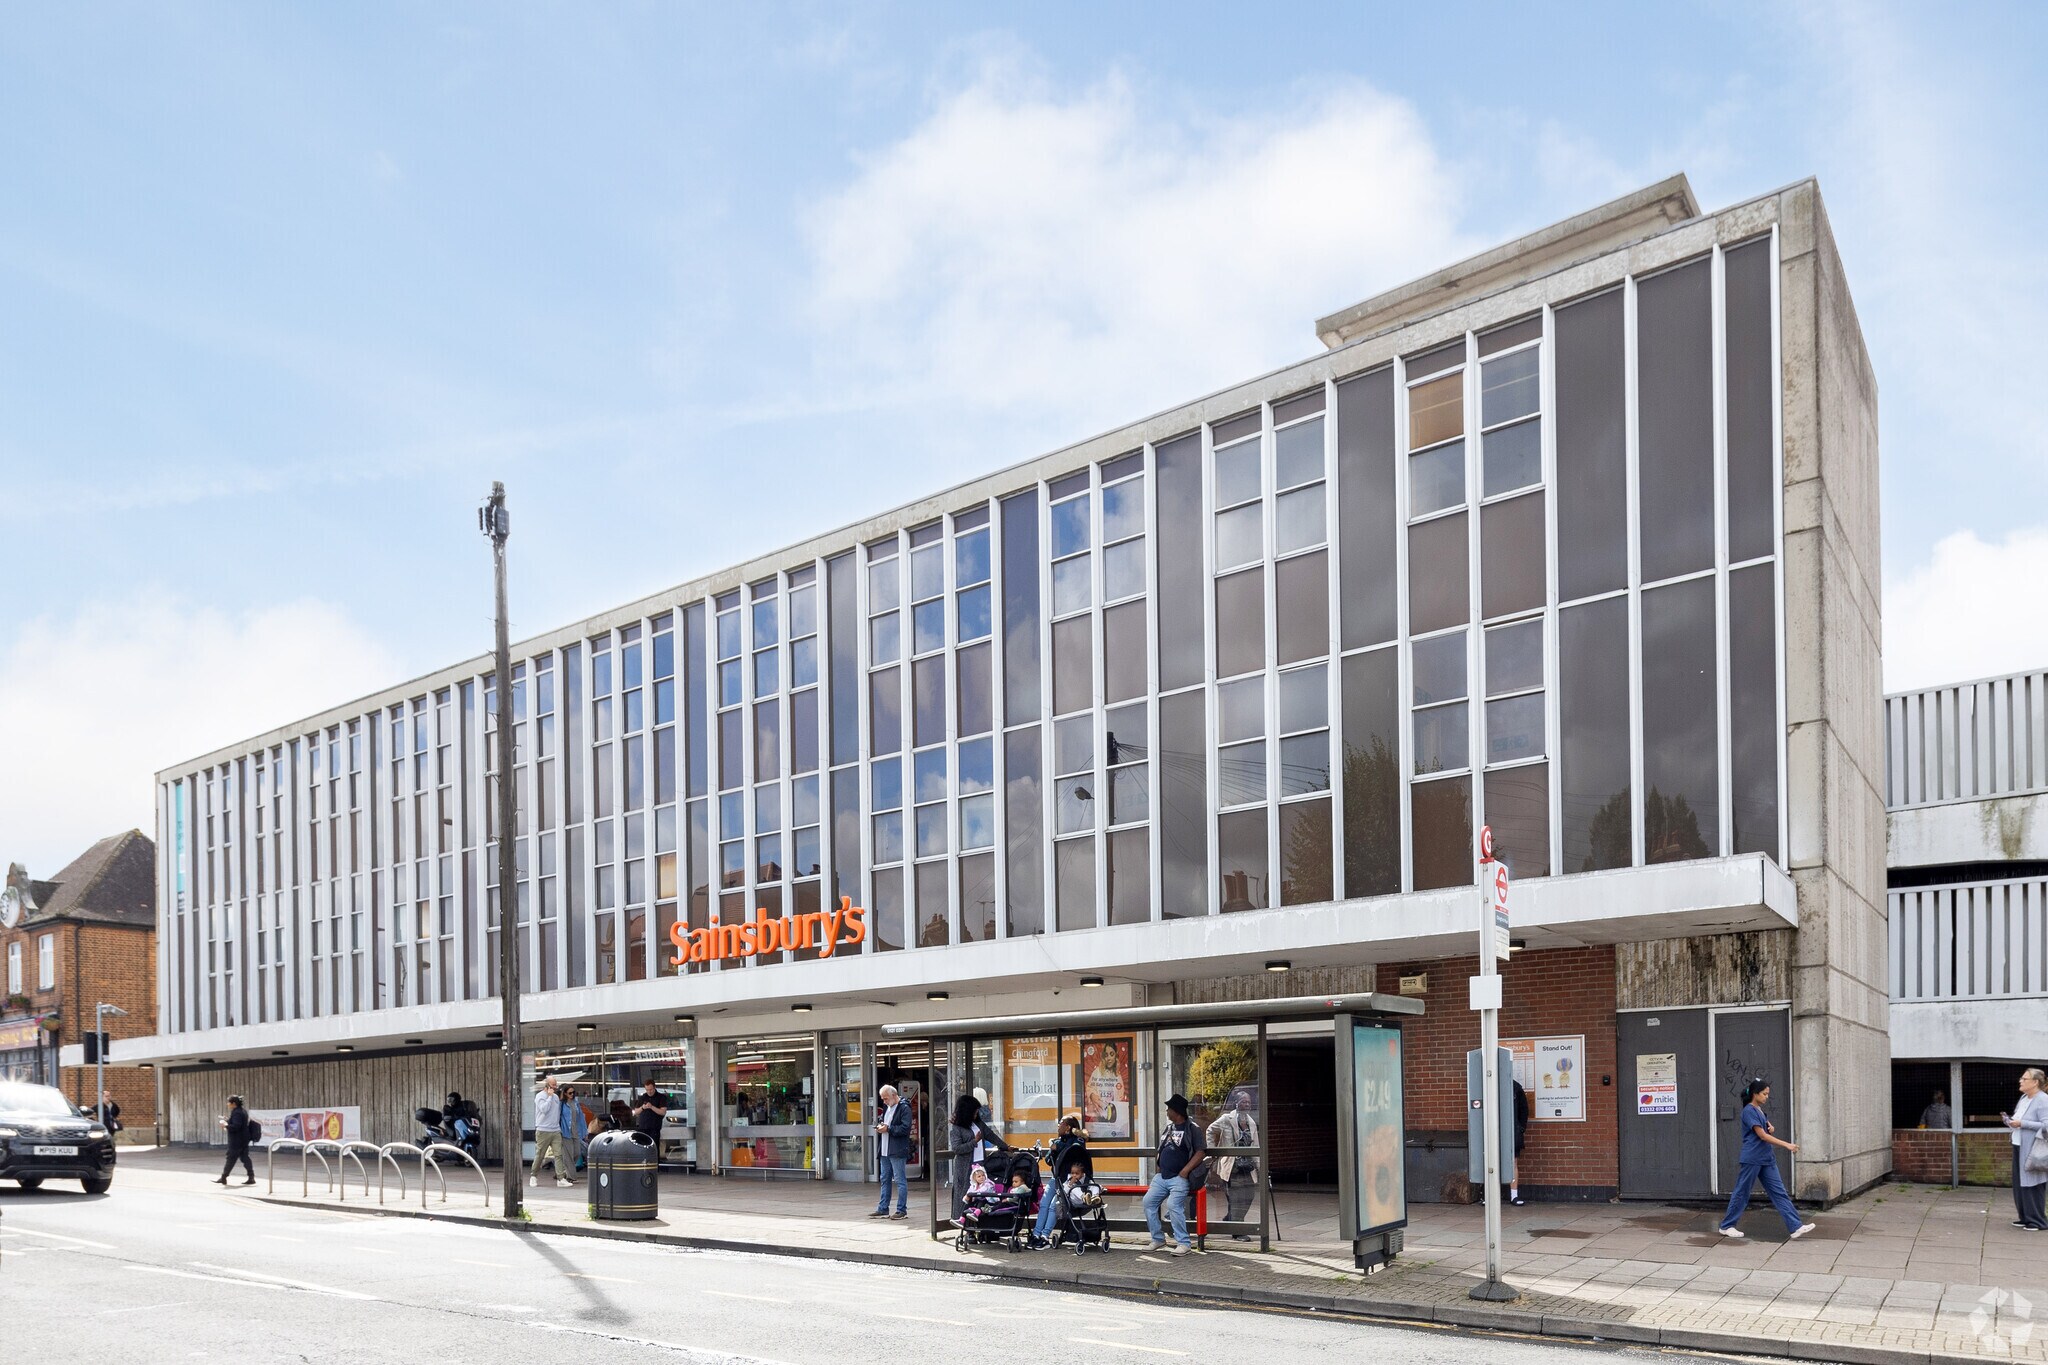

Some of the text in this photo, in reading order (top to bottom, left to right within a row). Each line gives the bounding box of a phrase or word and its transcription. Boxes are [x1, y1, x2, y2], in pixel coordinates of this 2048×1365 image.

[670, 895, 866, 966] Sainsbury's
[1012, 1048, 1048, 1060] Chingford
[1022, 1081, 1057, 1094] habitat
[1654, 1095, 1675, 1103] mitie
[58, 1146, 74, 1154] KUU
